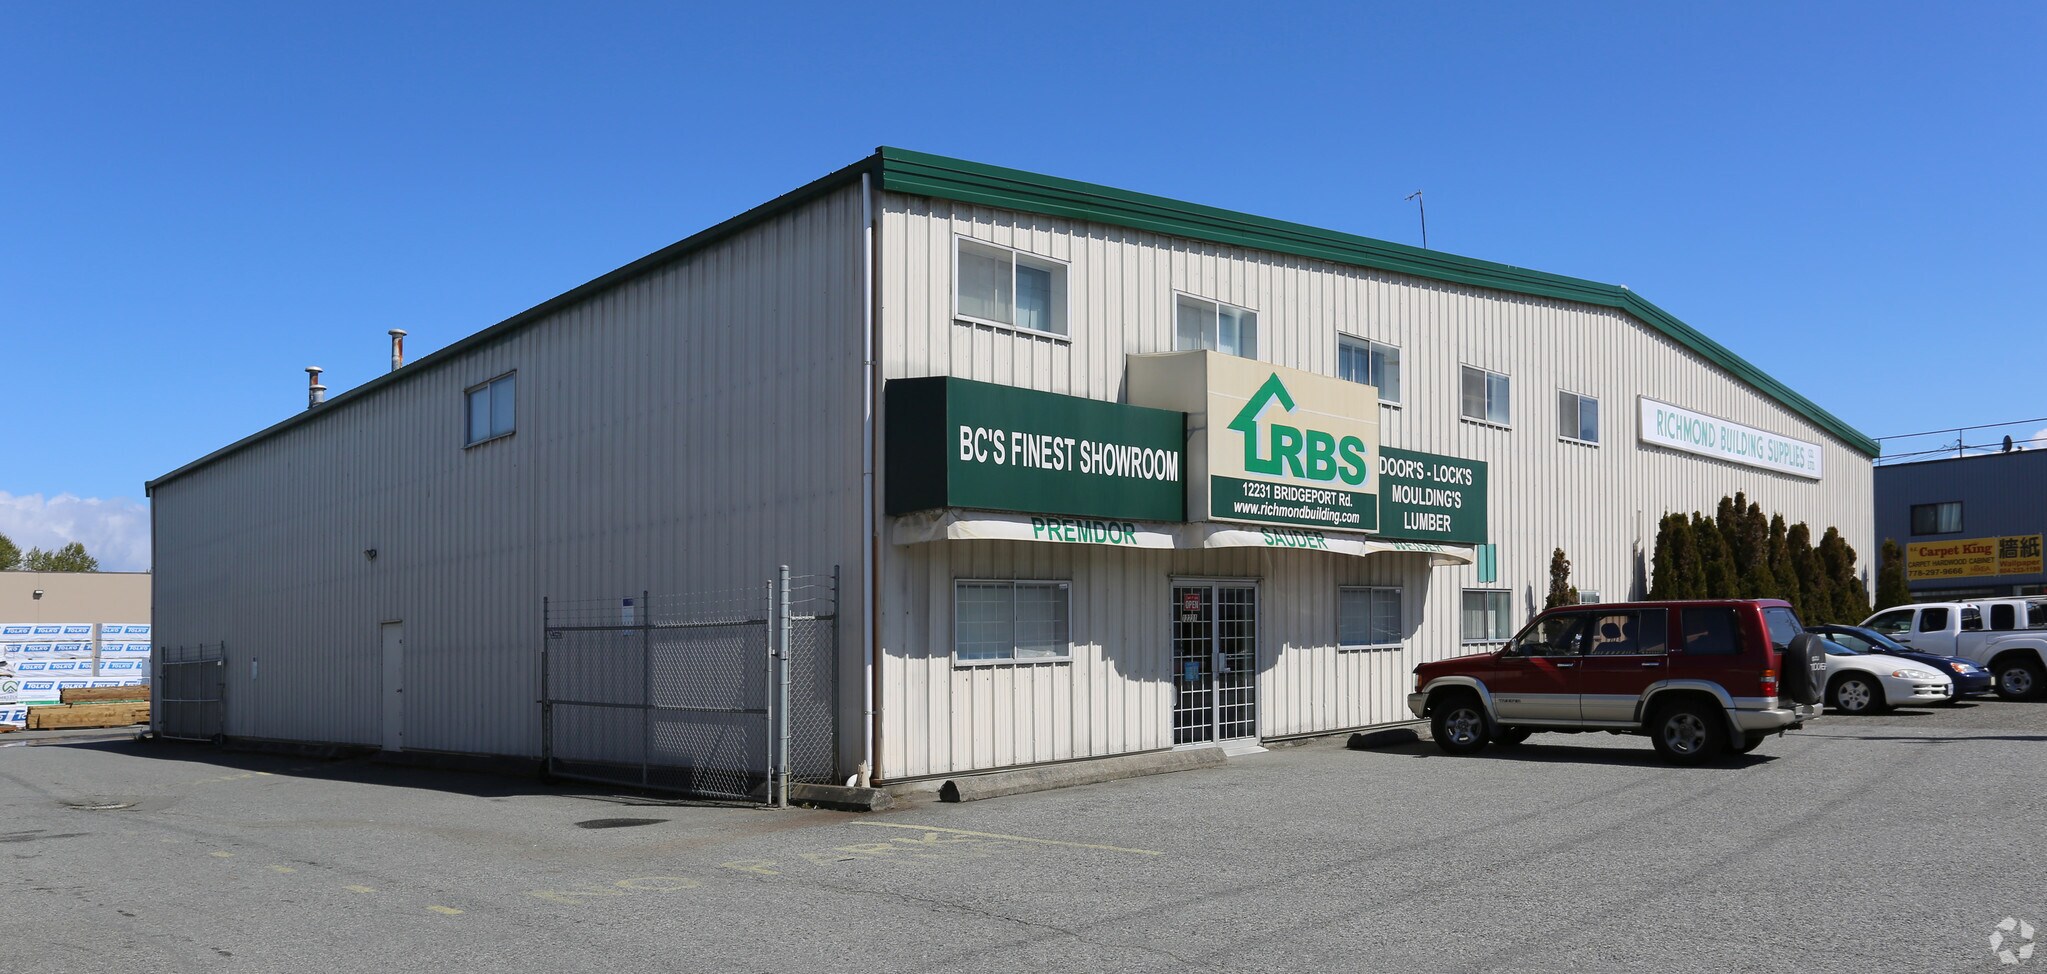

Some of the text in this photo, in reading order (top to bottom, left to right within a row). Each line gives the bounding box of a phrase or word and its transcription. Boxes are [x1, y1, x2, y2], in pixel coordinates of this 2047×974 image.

[1656, 408, 1805, 469] RICHMOND BUILDING SUPPLIES
[959, 425, 1179, 482] BC'S FINEST SHOWROOM
[1270, 423, 1367, 486] RBS
[1379, 455, 1424, 480] DOOR'S
[1433, 464, 1473, 486] LOCK'S
[1242, 481, 1353, 507] 12231 BRIDGEPORT Rd.
[1392, 484, 1462, 509] MOULDING'S
[1233, 501, 1360, 525] www.richmondbuilding.com
[1404, 511, 1451, 532] LUMBER
[1030, 516, 1138, 545] PREMDOR
[1260, 527, 1329, 549] SAUDER
[1908, 556, 1995, 568] CARPET HARDWOOD CABINET
[1919, 546, 1959, 558] Carpet
[1962, 543, 1993, 556] King
[2000, 559, 2040, 568] Wallpaper
[1184, 600, 1199, 609] OPEN
